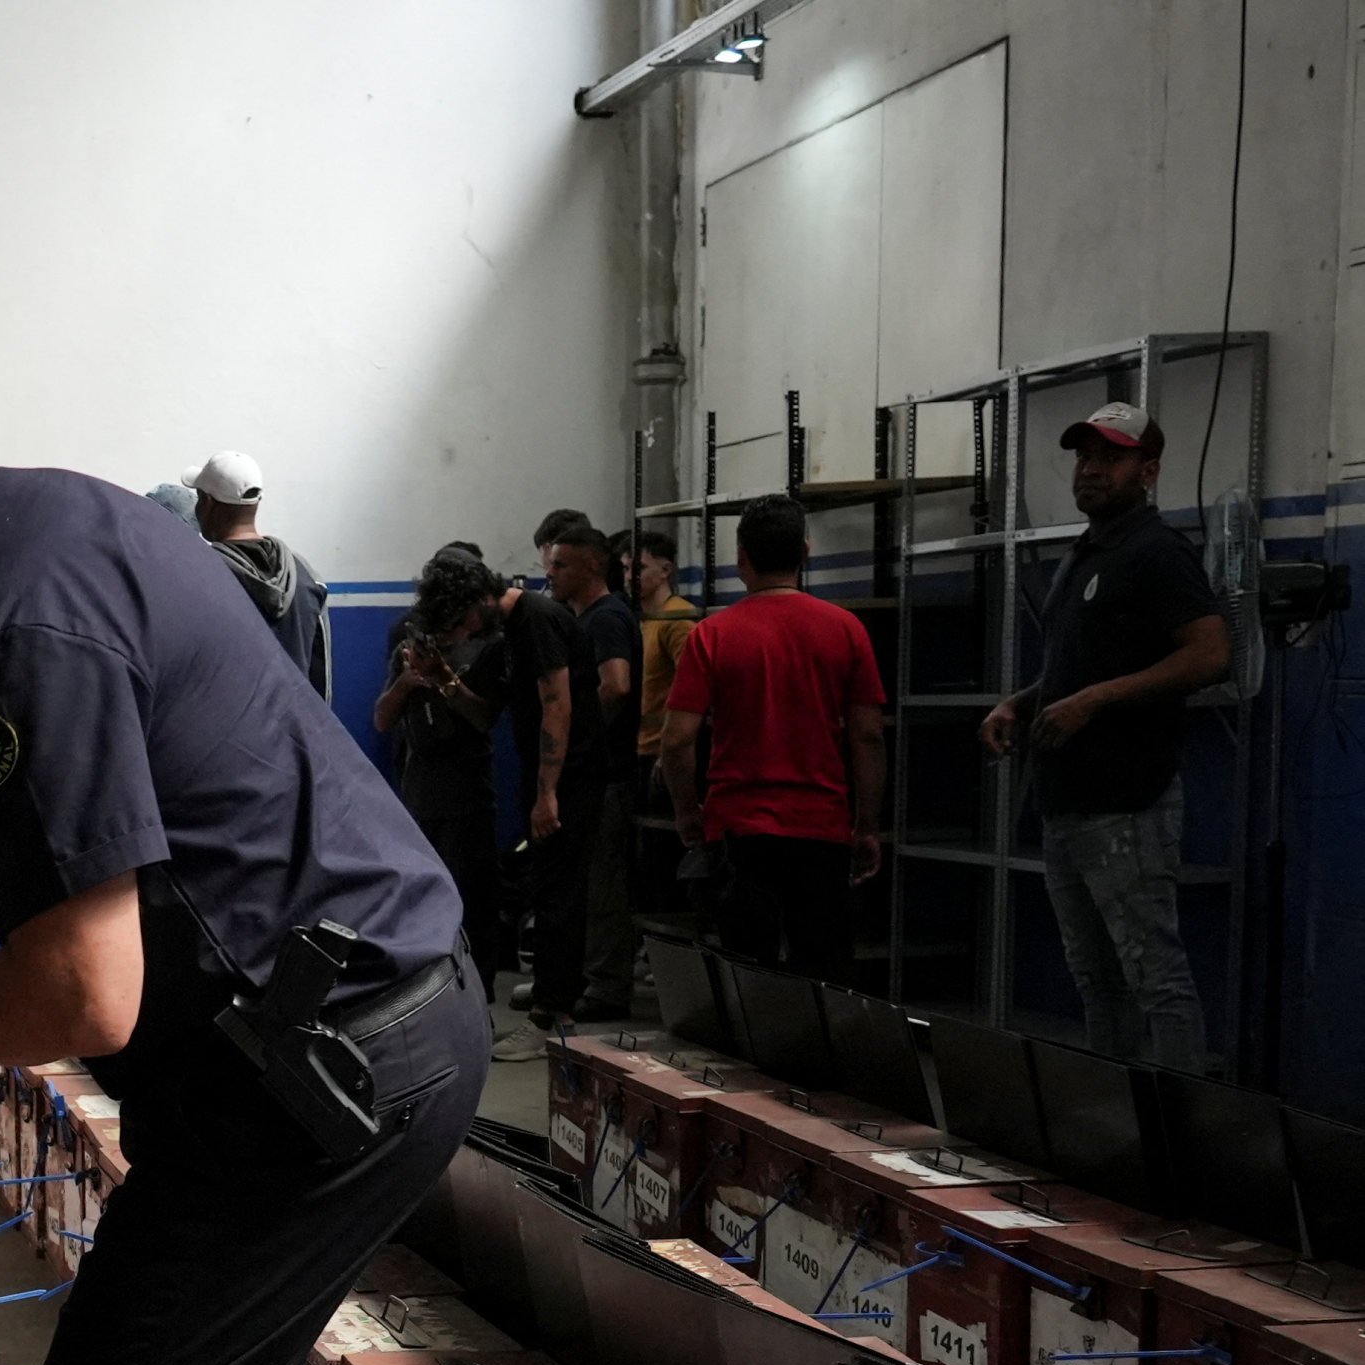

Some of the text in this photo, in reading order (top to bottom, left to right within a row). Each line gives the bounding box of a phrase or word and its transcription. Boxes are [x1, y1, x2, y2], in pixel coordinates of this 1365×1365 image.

[561, 1125, 584, 1153] 1405
[639, 1172, 667, 1204] 1407
[785, 1243, 819, 1280] 1409
[931, 1325, 975, 1365] 1411
